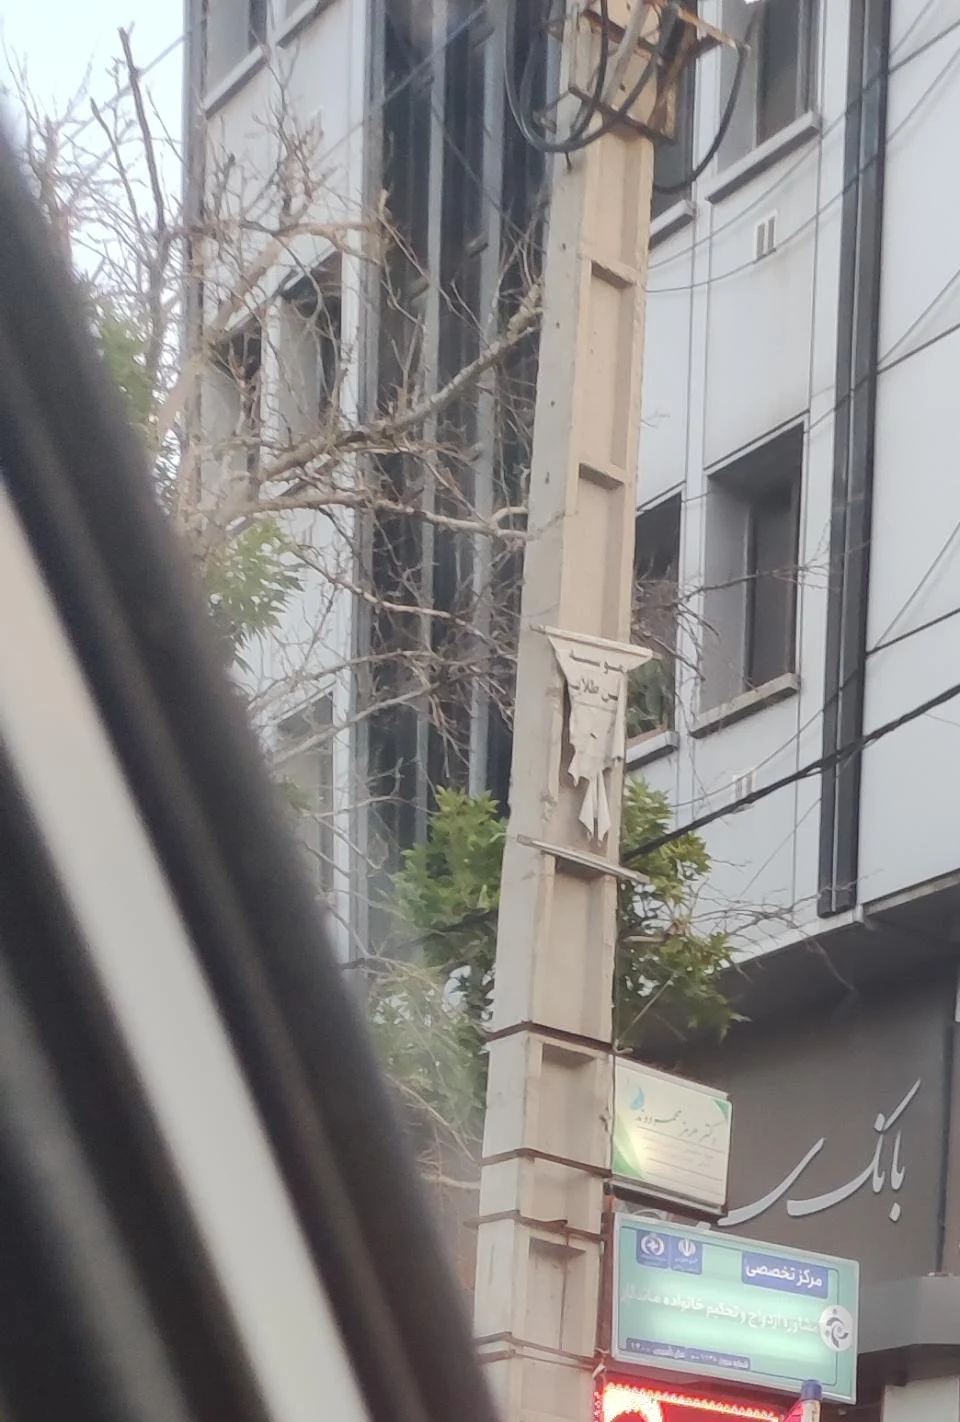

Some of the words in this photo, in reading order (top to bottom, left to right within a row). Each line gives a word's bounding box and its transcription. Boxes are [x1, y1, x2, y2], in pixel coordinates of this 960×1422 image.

[787, 1077, 921, 1223] بانک
[745, 1263, 796, 1282] تخصصی
[796, 1269, 823, 1288] مرکز
[663, 1295, 705, 1313] خانواده
[706, 1302, 739, 1319] تحکیم
